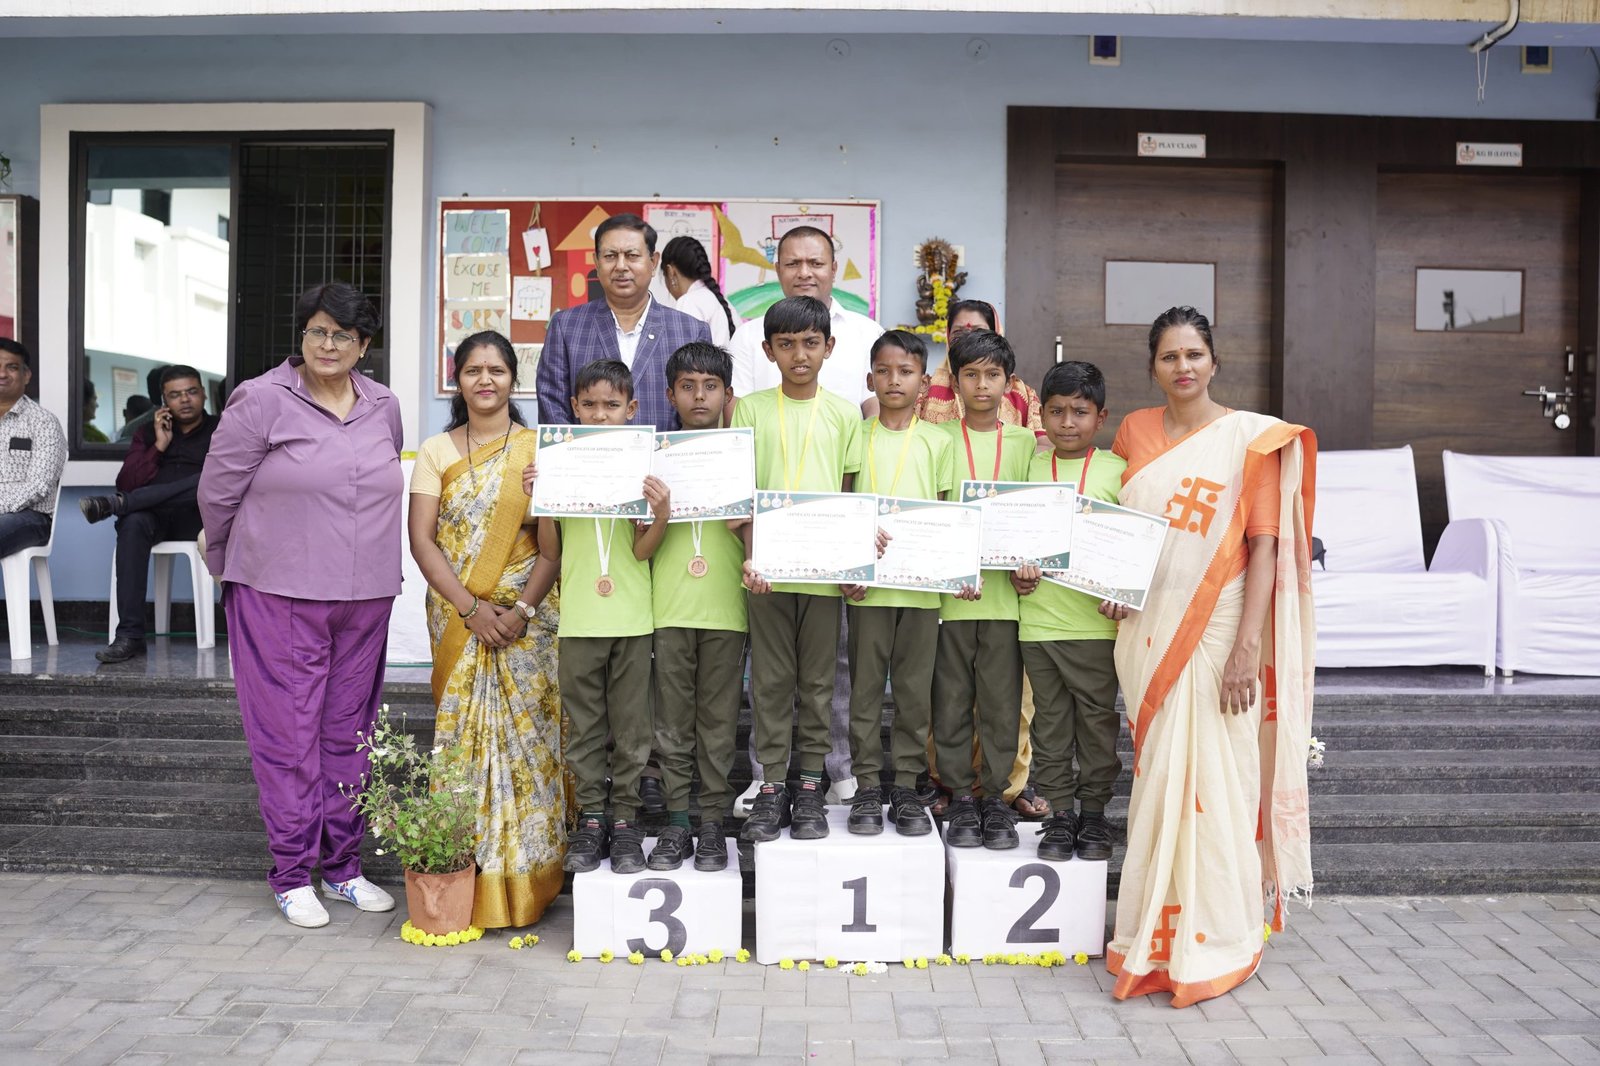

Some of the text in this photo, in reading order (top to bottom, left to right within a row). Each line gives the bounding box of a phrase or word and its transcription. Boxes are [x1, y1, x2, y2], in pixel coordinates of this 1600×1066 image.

[461, 235, 503, 253] COME
[470, 281, 492, 297] ME
[451, 308, 506, 331] SORRY
[626, 878, 688, 958] 3
[841, 876, 877, 933] 1
[1005, 863, 1061, 944] 2
